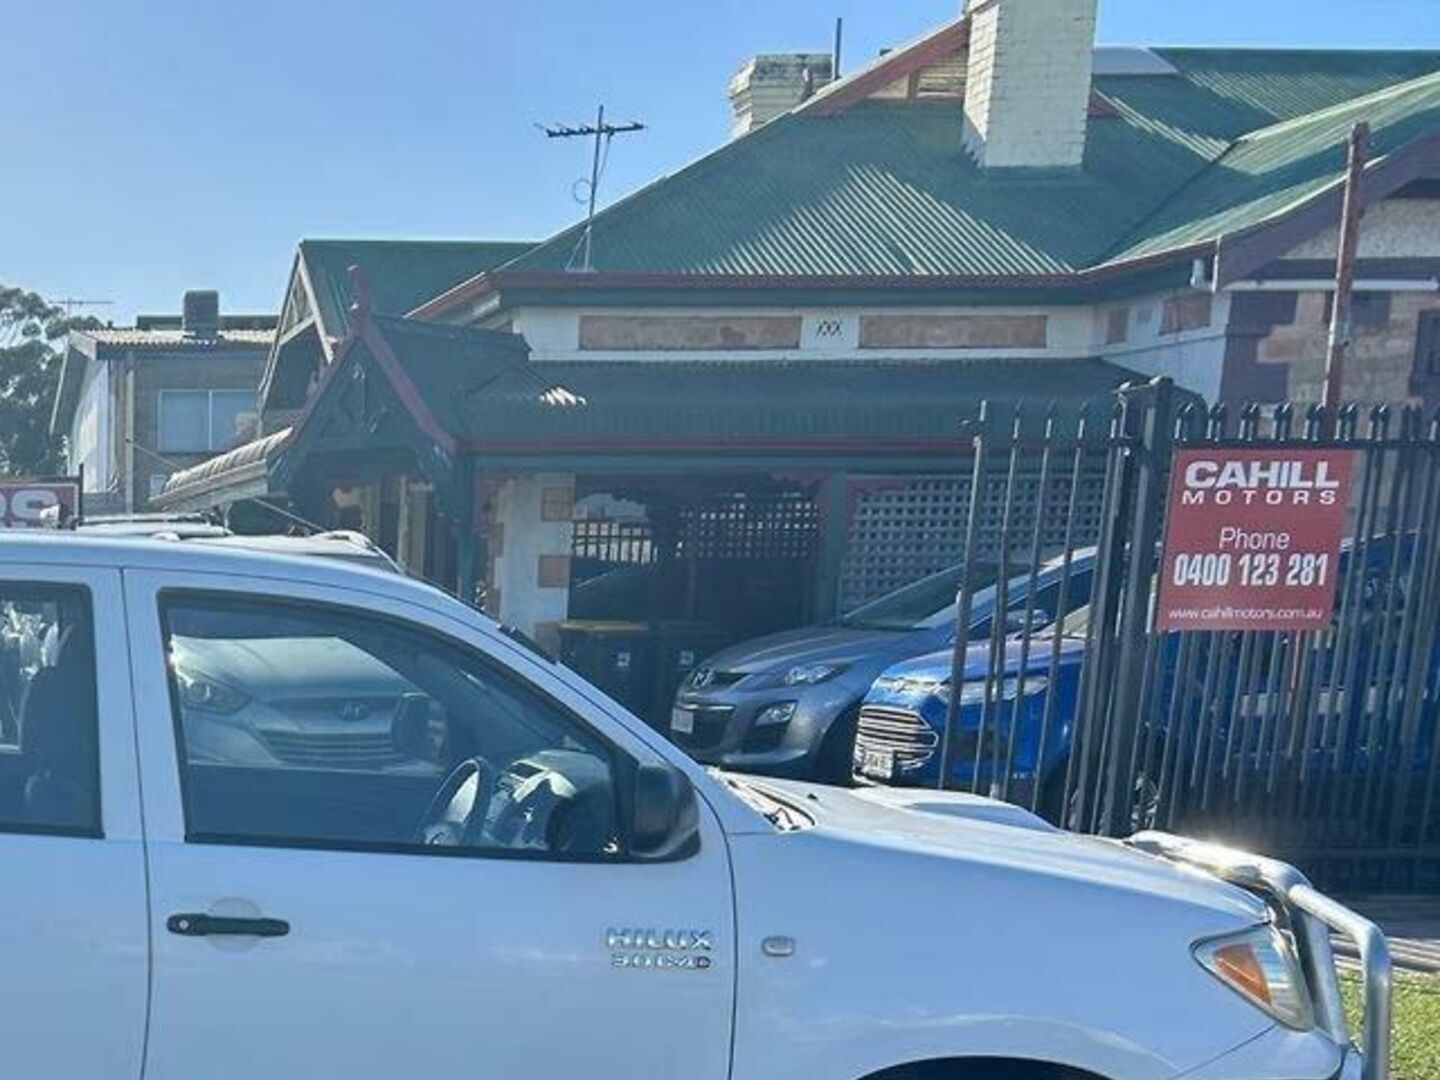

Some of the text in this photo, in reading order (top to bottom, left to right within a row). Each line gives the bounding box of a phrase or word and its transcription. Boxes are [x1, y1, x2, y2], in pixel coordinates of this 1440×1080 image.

[1185, 460, 1339, 488] CAHILL
[1182, 490, 1336, 505] MOTORS
[1219, 526, 1290, 550] Phone
[1173, 553, 1328, 586] 0400 123 281
[1169, 606, 1323, 620] www.cahillmotors.com.au
[607, 929, 711, 950] HILUX
